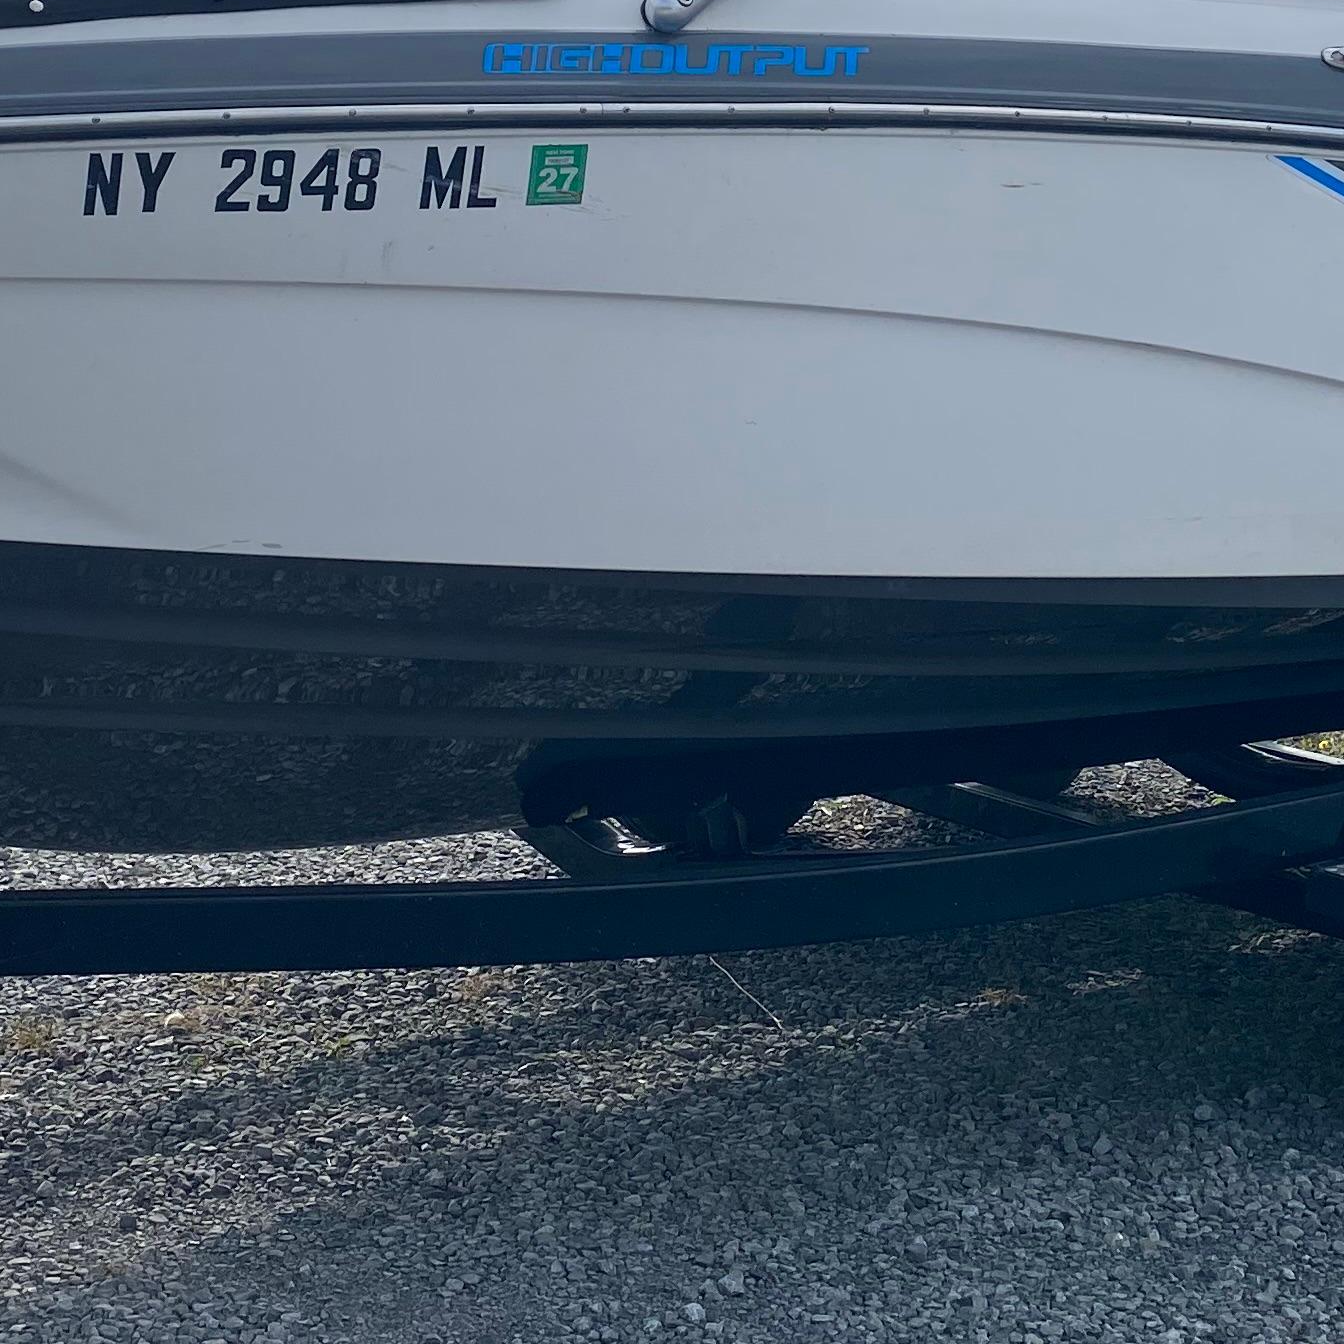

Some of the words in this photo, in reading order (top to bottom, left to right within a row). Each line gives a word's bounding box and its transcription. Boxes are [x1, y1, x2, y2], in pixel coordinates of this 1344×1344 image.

[83, 151, 176, 216] NY
[214, 148, 382, 212] 2948
[418, 145, 498, 210] ML
[536, 167, 579, 193] 27
